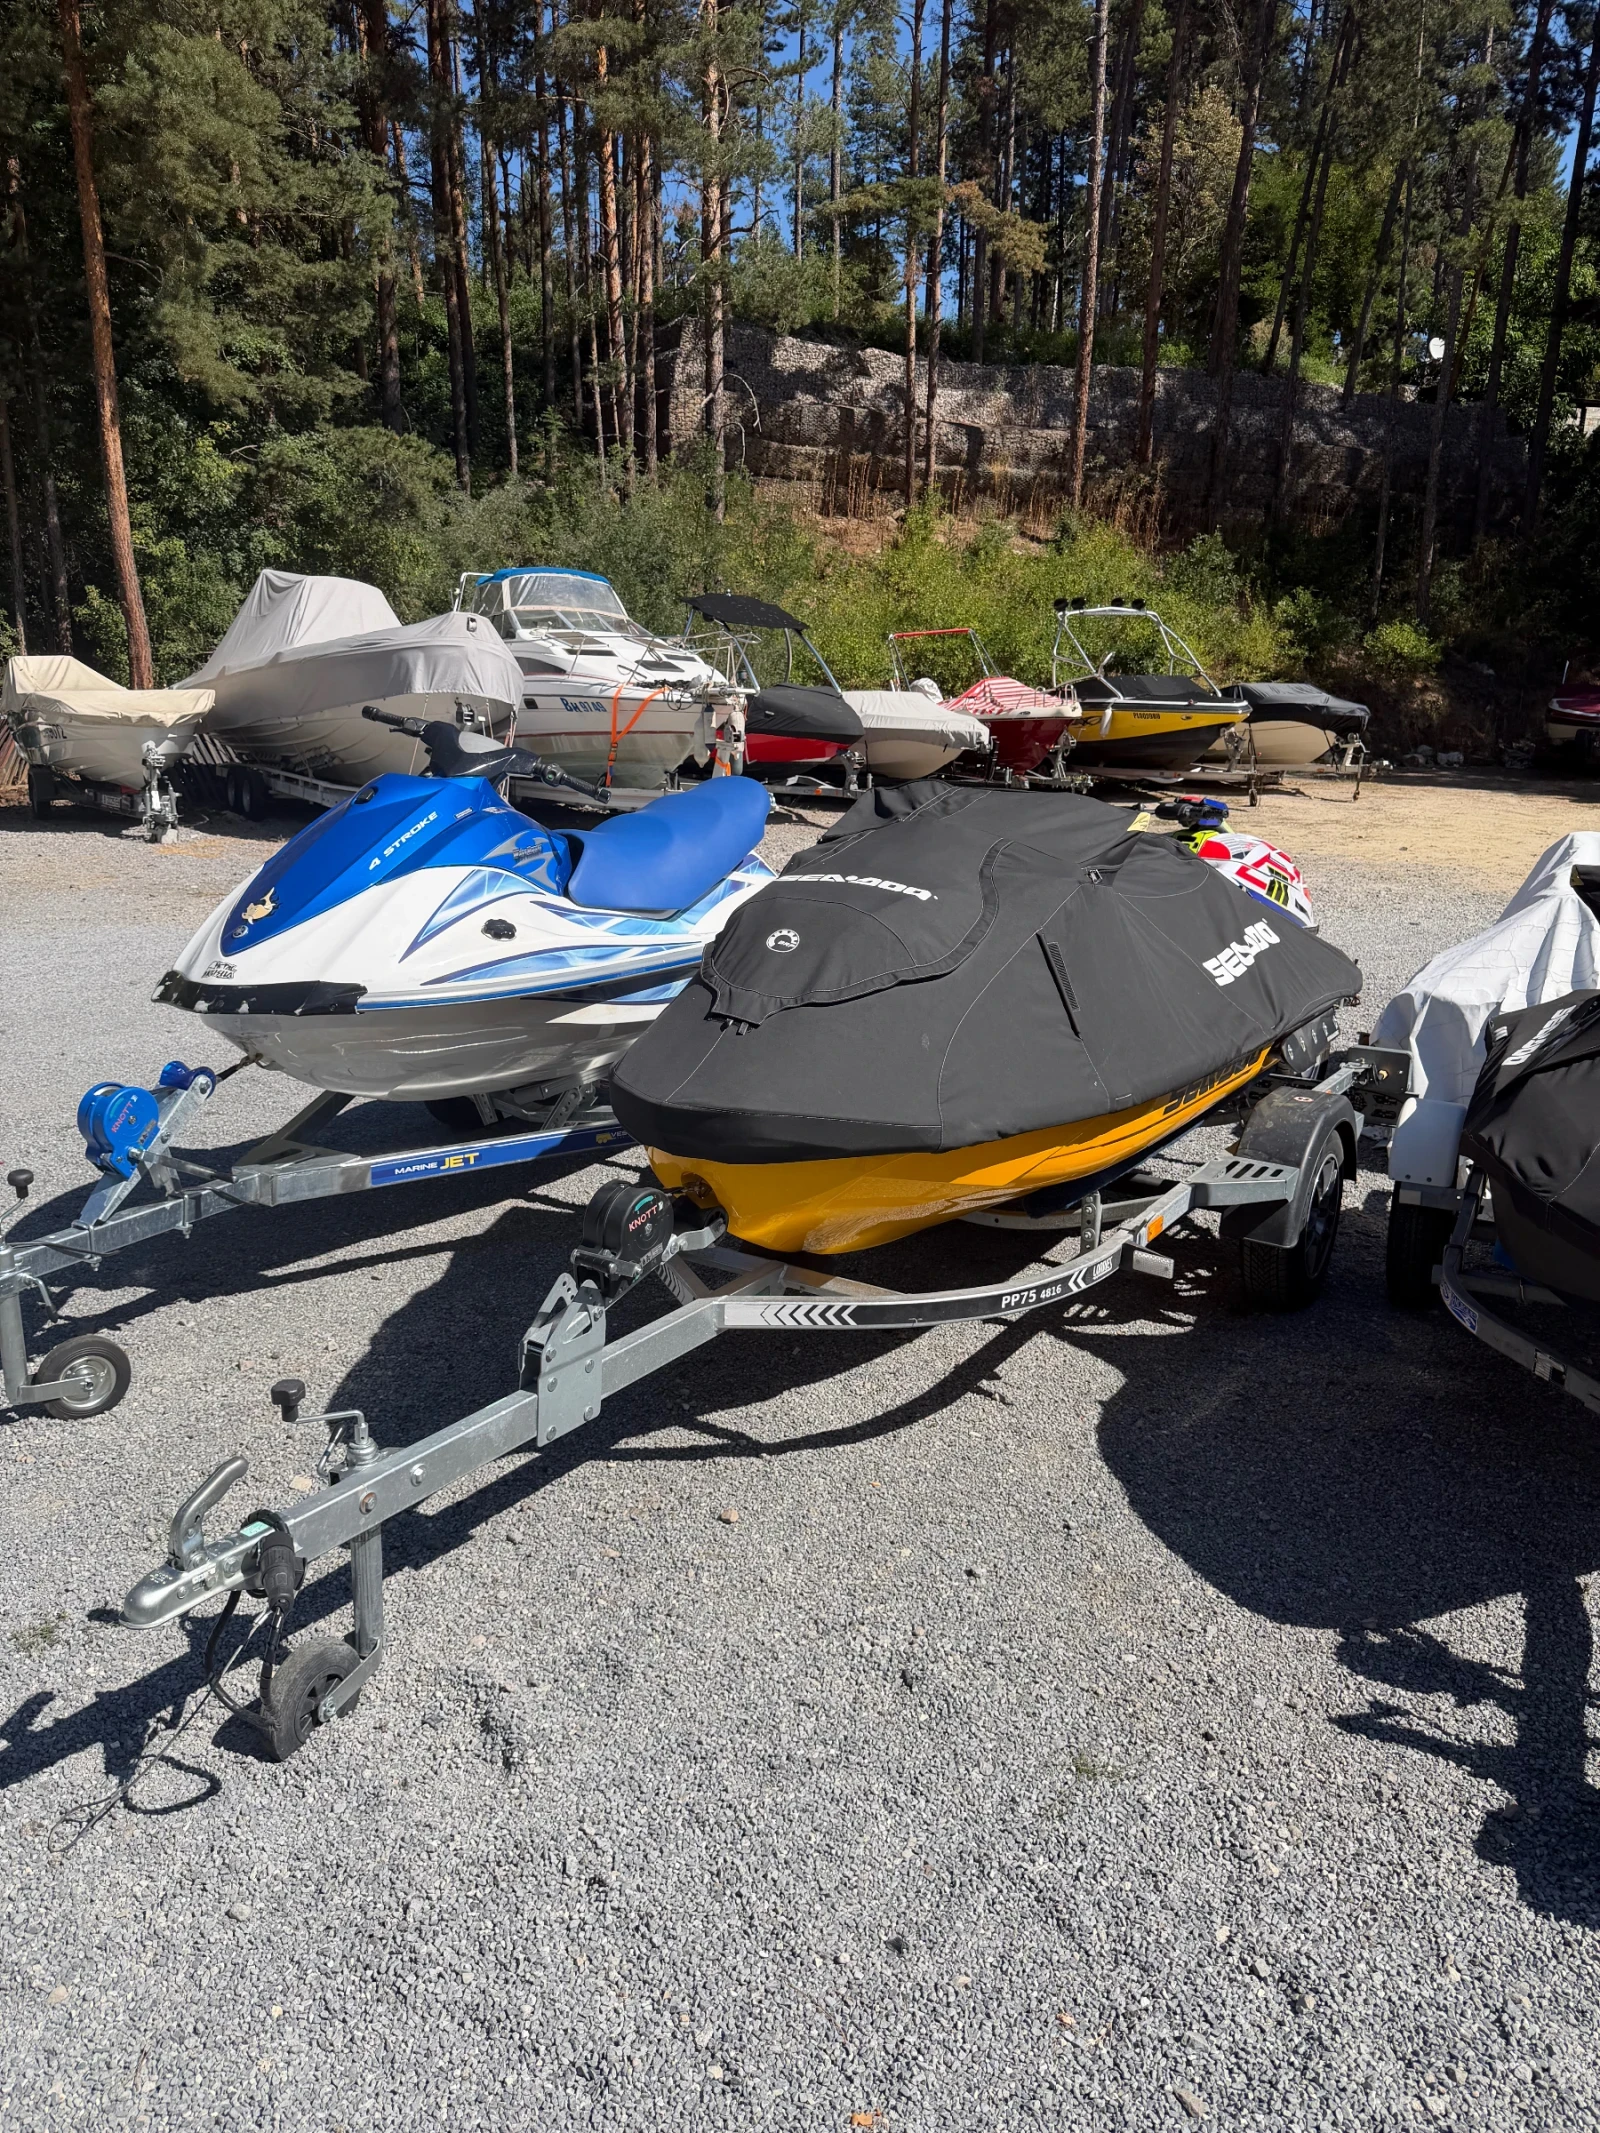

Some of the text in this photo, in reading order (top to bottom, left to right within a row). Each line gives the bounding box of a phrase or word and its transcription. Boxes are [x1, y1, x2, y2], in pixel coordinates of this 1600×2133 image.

[369, 857, 381, 870] 4
[383, 811, 438, 857] STROKE
[111, 1101, 133, 1133] KNOTT
[394, 1152, 479, 1175] MARINE JET
[628, 1205, 658, 1232] KNOTT
[1001, 1289, 1037, 1309] PP75
[1040, 1284, 1062, 1299] 4816
